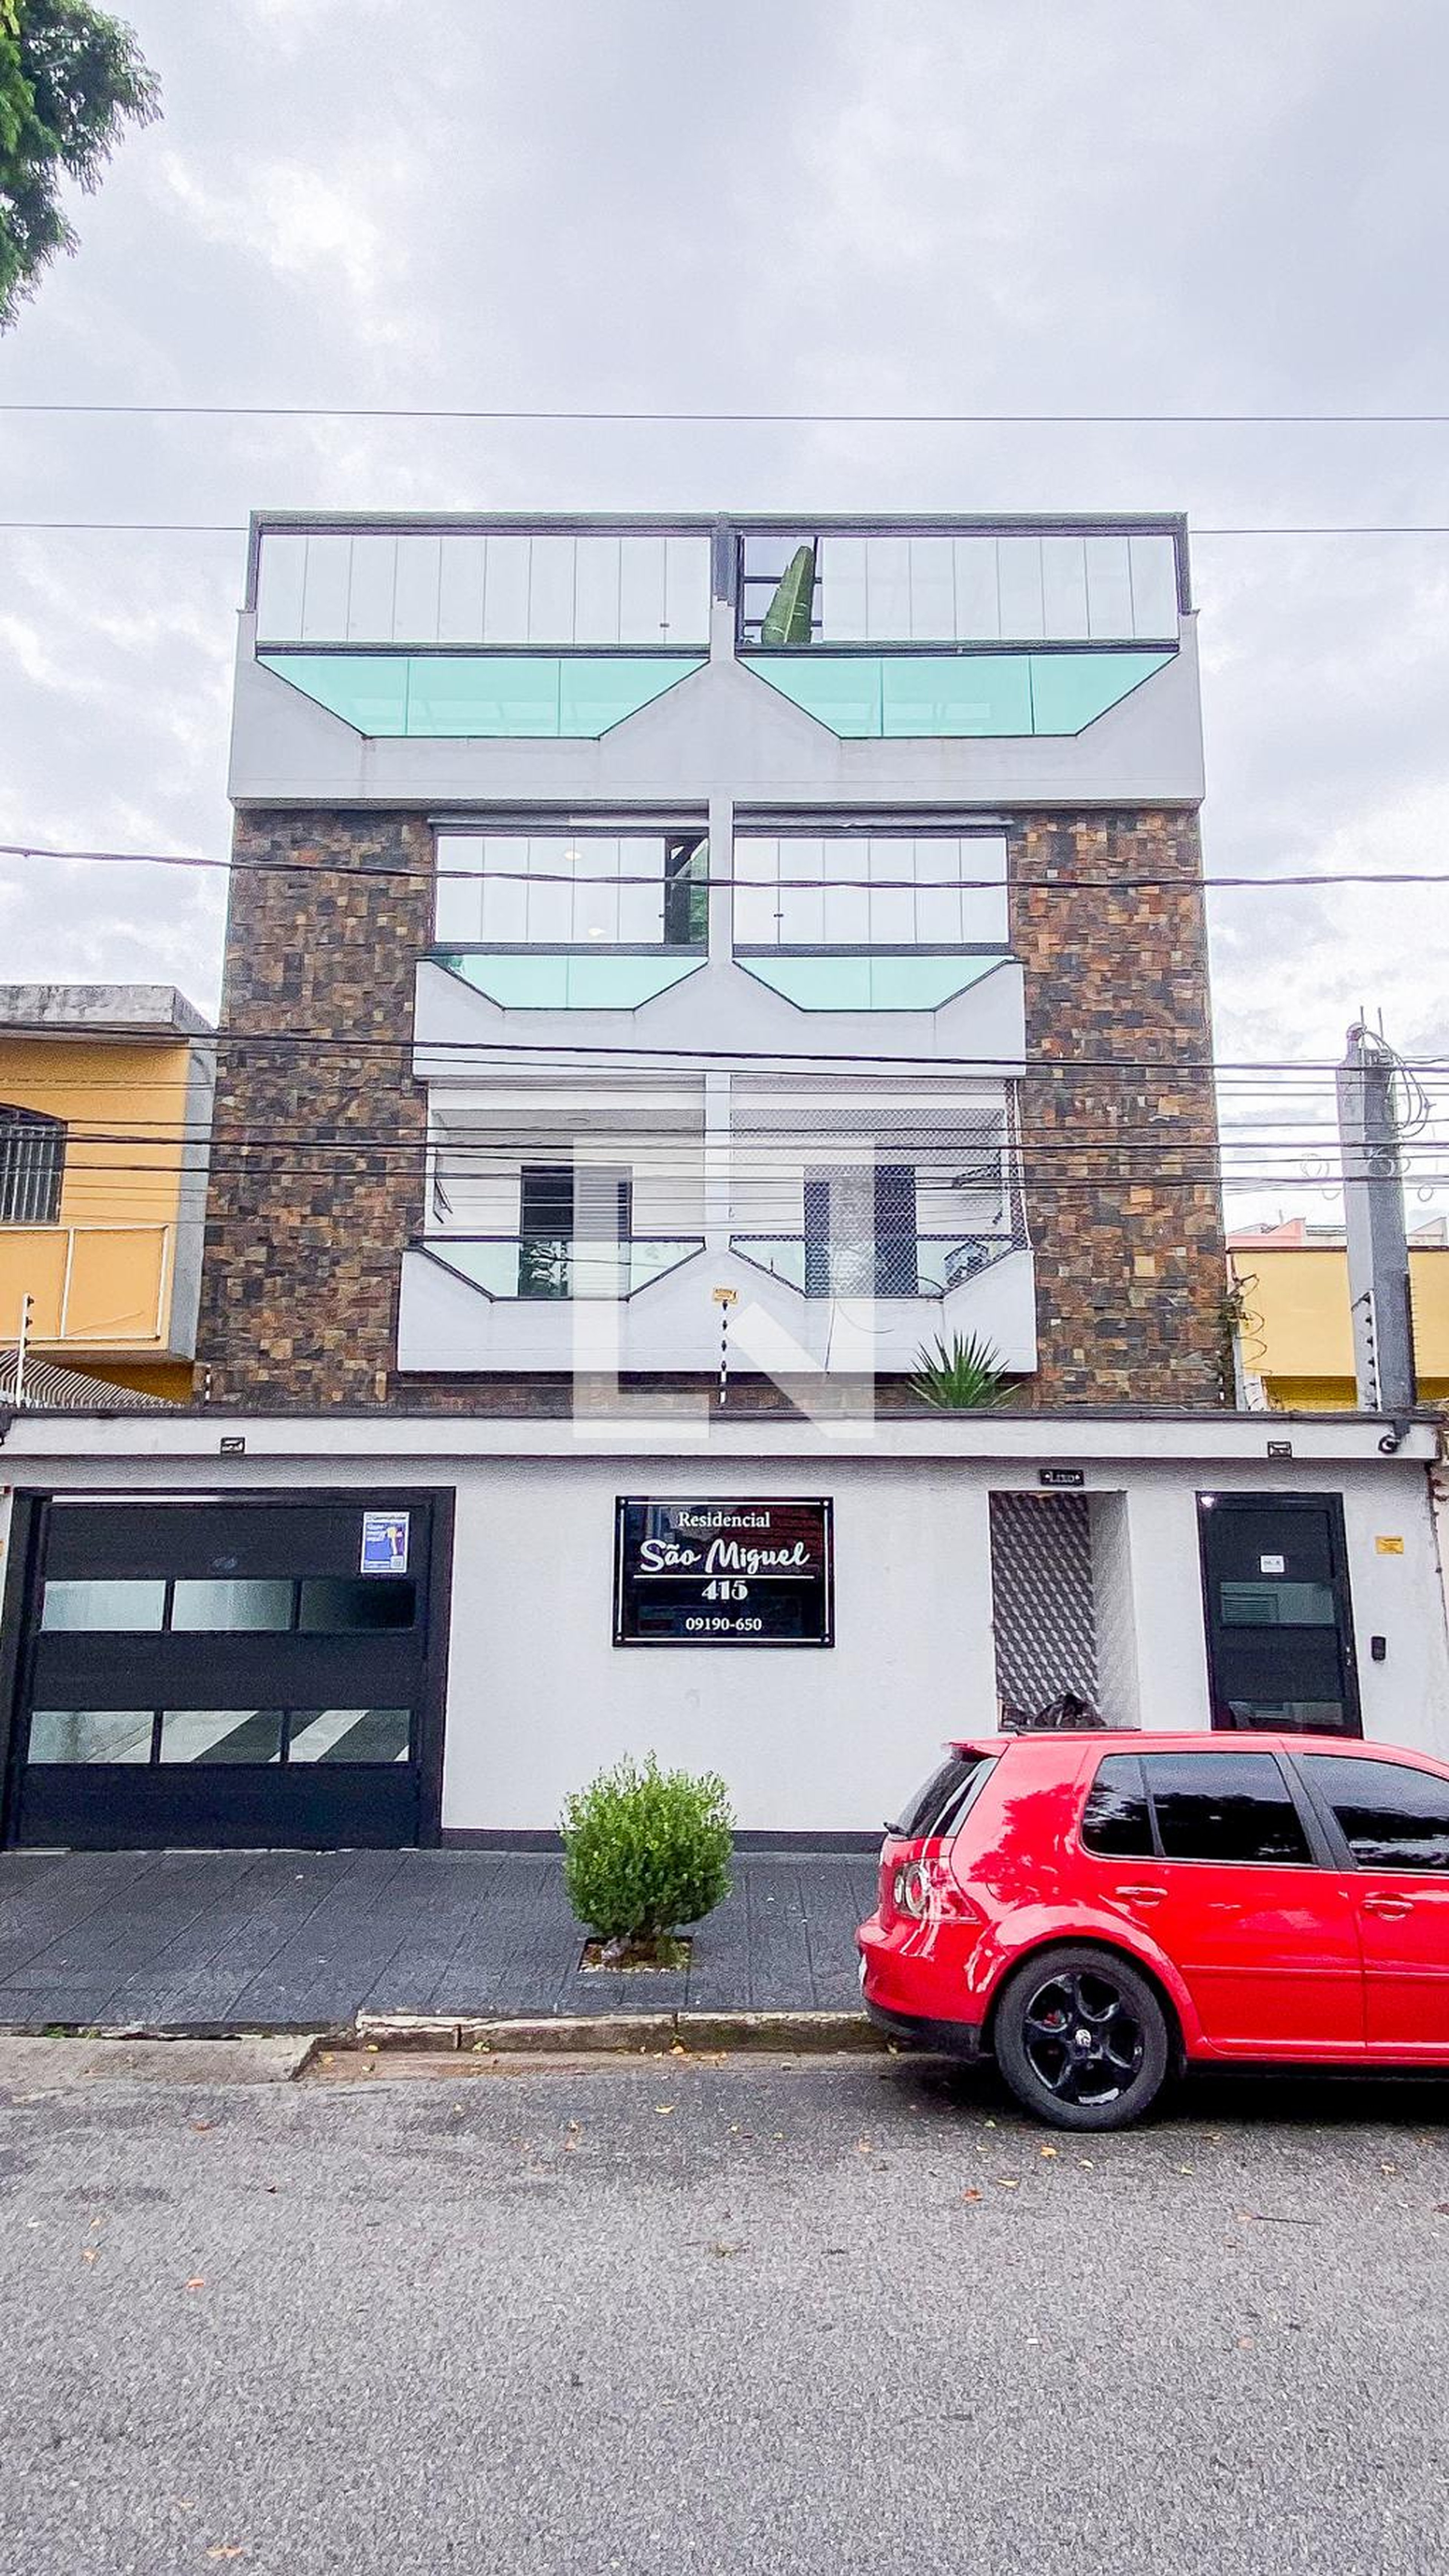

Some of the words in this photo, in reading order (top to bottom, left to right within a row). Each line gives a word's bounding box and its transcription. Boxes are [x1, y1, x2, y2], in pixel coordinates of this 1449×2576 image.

[1049, 1471, 1075, 1483] Lixo
[678, 1512, 770, 1527] Residencial
[640, 1539, 701, 1572] São
[705, 1538, 810, 1574] Miguel
[701, 1580, 748, 1600] 415
[686, 1617, 762, 1631] 09190-650
